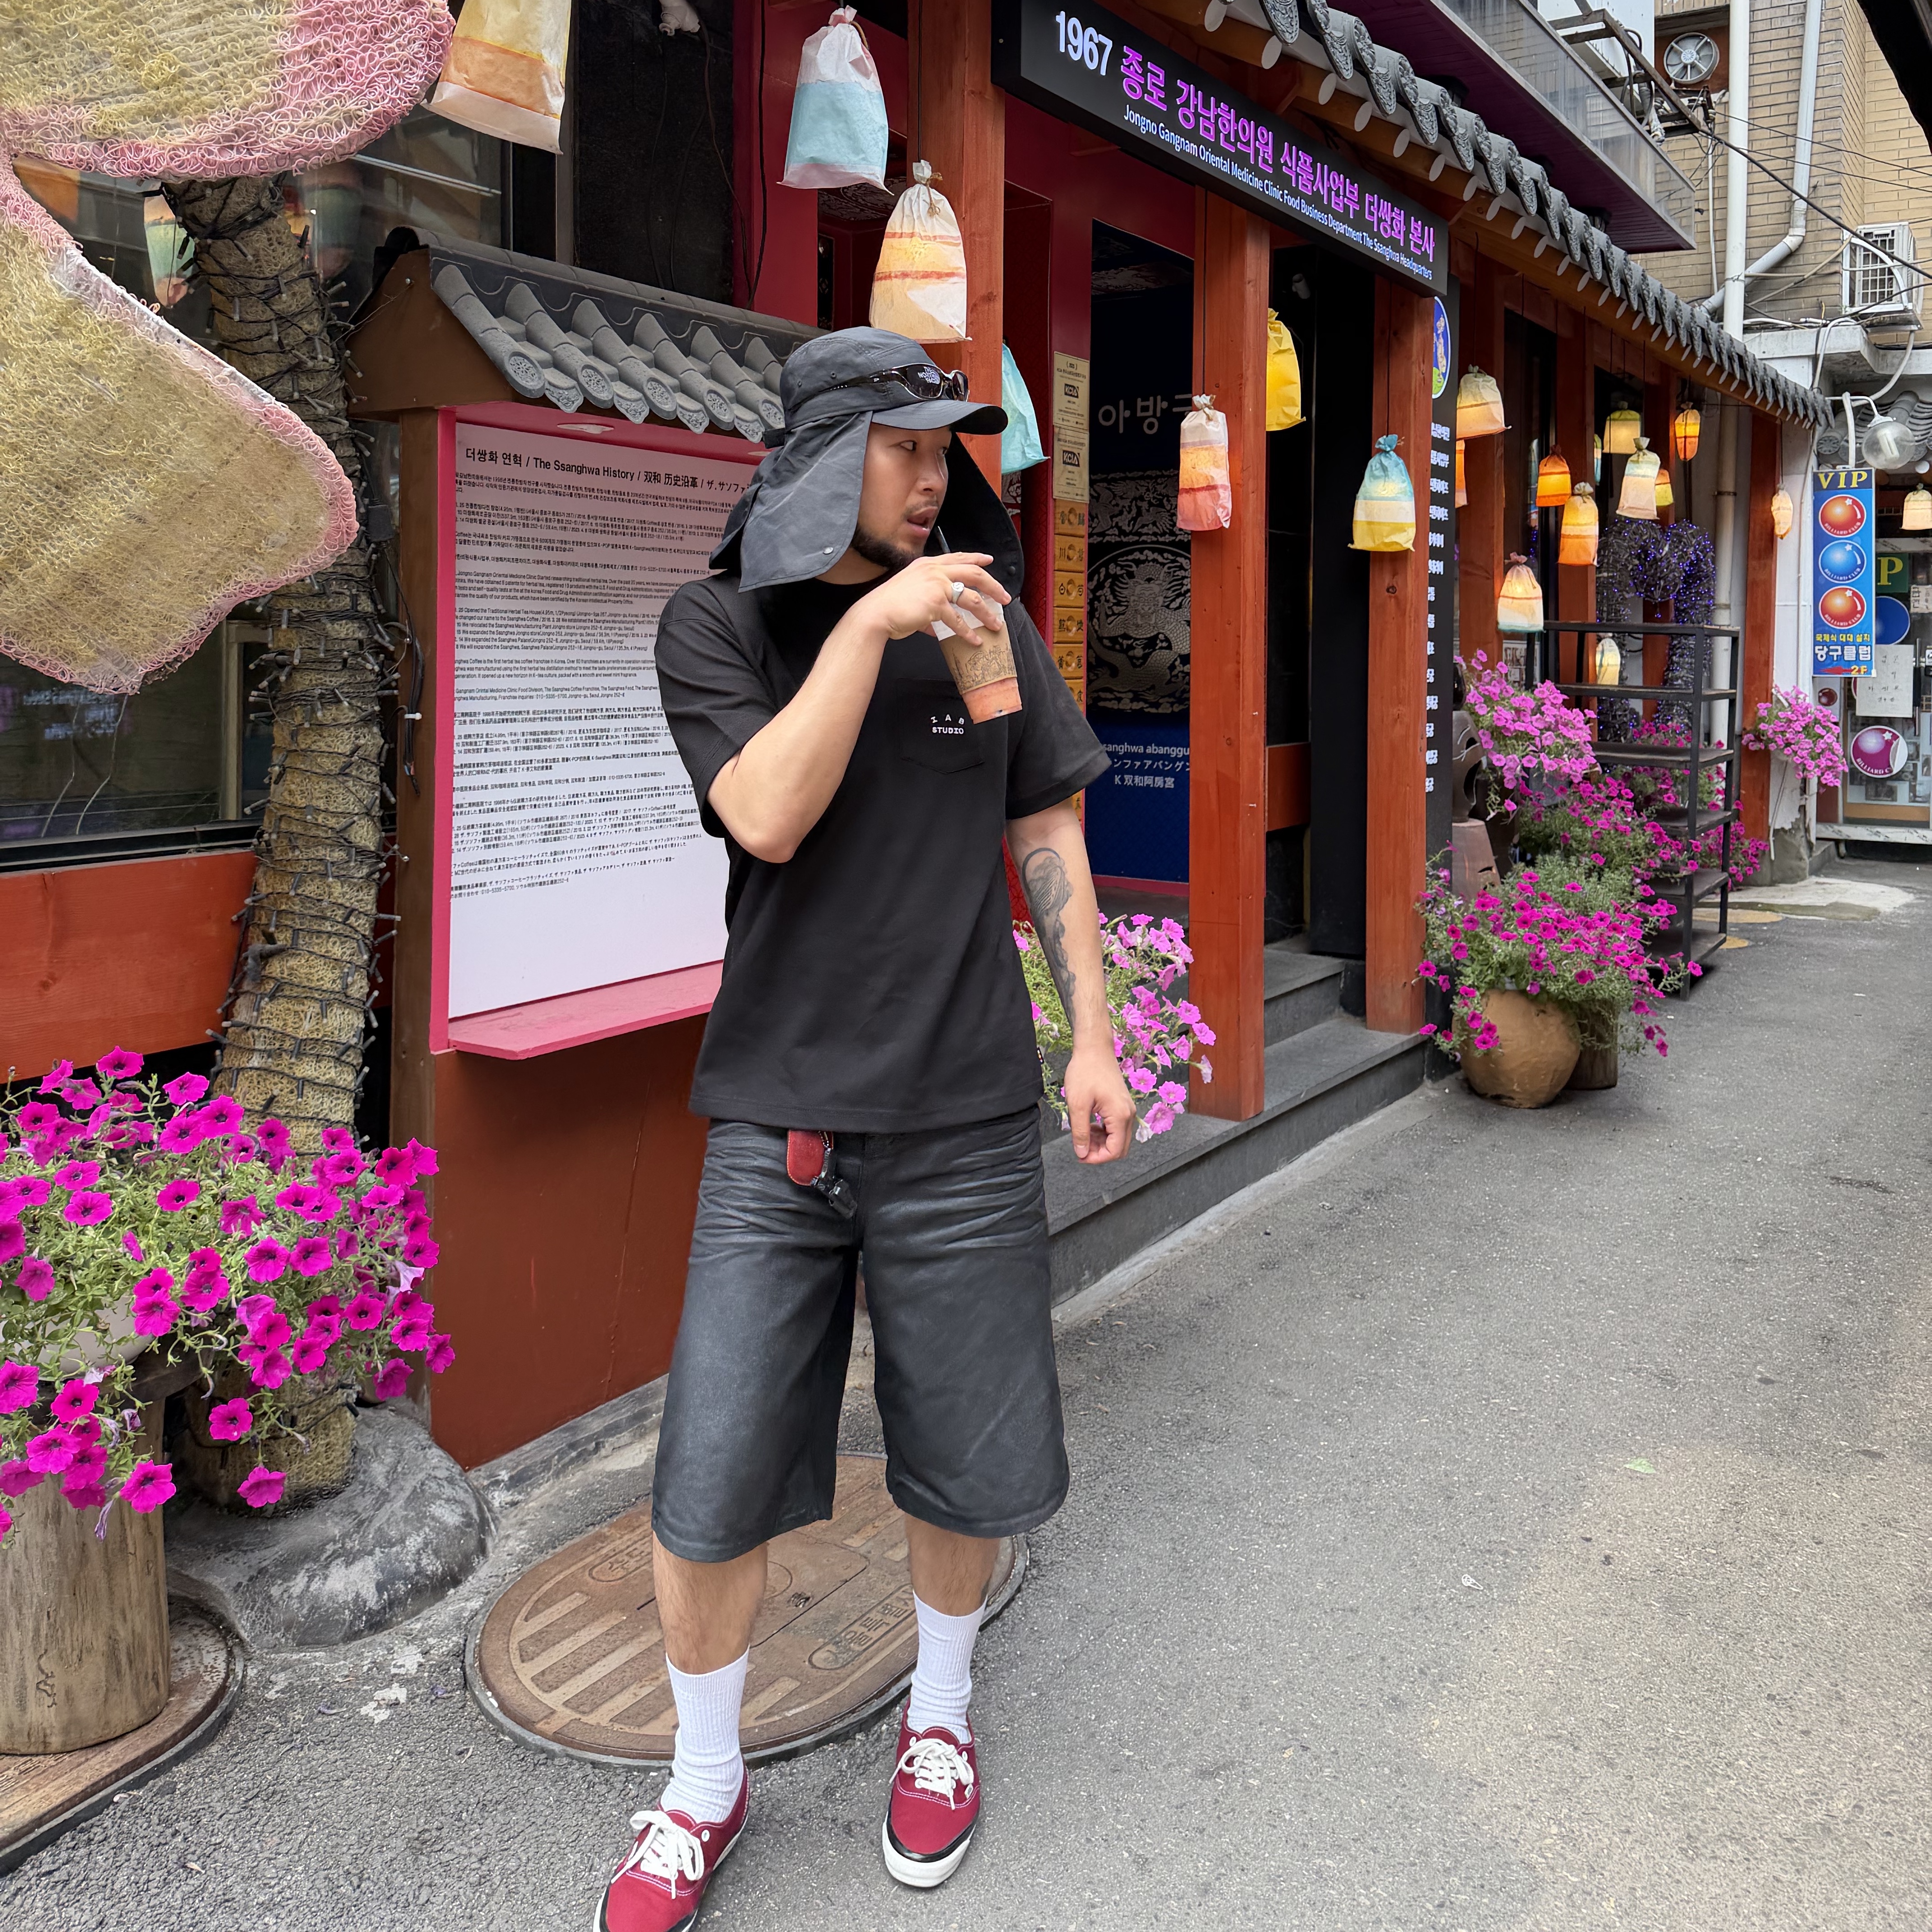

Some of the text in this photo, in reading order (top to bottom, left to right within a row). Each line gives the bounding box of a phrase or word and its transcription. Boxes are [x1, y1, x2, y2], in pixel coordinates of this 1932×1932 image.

[1056, 11, 1435, 262] 1967 종로 강남한의원 식품사업부 더쌍화 본사
[1124, 105, 1432, 280] Jongno Gangnam Oriental Medicine Clinic Food Business Department The Ssanghwa Headquarters
[466, 448, 497, 464] 더쌍화
[501, 452, 521, 467] 연혁
[533, 457, 551, 469] The
[554, 460, 600, 475] Ssanghwa
[603, 467, 635, 481] History
[644, 471, 661, 484] 双和
[1817, 471, 1868, 489] VIP
[1815, 645, 1871, 662] 당구클럽
[1851, 665, 1868, 675] 2F
[930, 714, 964, 725] IAB
[1856, 758, 1883, 774] BILLIARD
[1115, 774, 1122, 785] K
